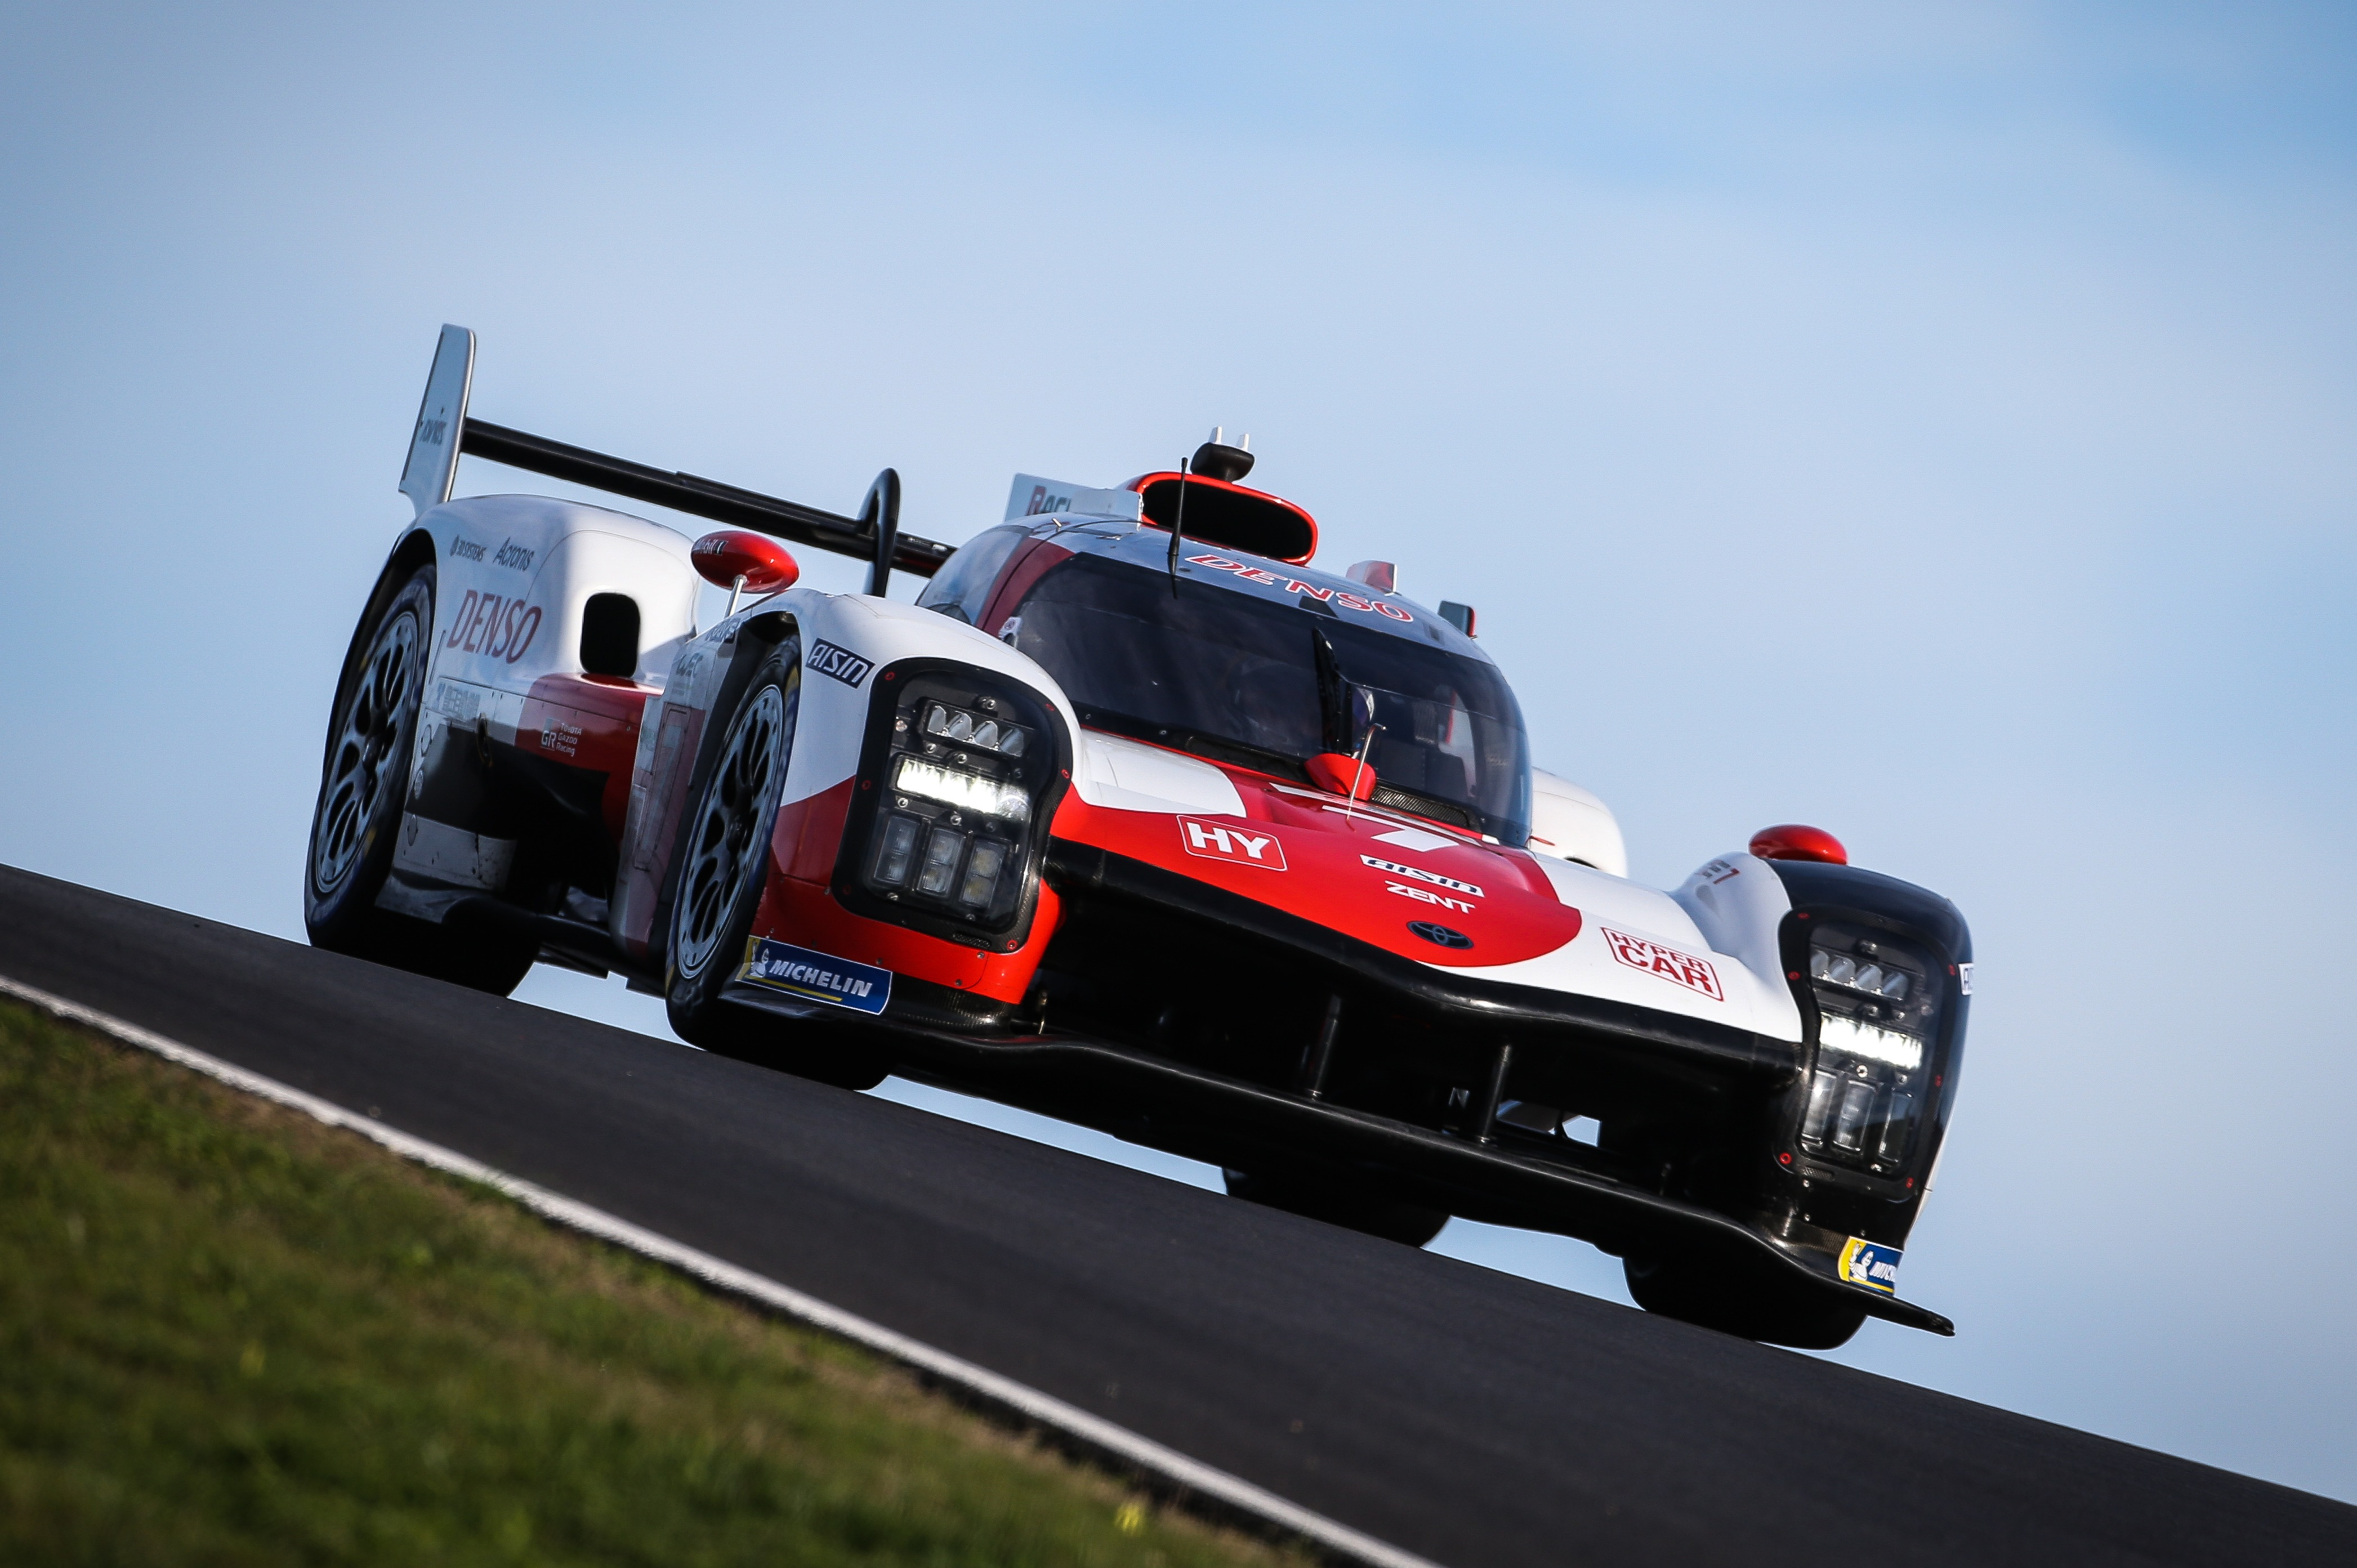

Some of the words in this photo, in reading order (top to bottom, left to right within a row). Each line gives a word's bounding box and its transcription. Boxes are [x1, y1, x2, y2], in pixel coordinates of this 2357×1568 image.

[493, 537, 534, 572] Acronis
[1184, 553, 1414, 623] DENSO
[447, 588, 542, 665] DENSO
[808, 644, 869, 683] AISIN
[541, 730, 556, 748] GR
[1186, 822, 1270, 859] HY
[1385, 880, 1476, 913] ZENT
[1610, 932, 1706, 973] HYPER
[1618, 945, 1714, 994] CAR
[769, 959, 872, 997] MICHELIN
